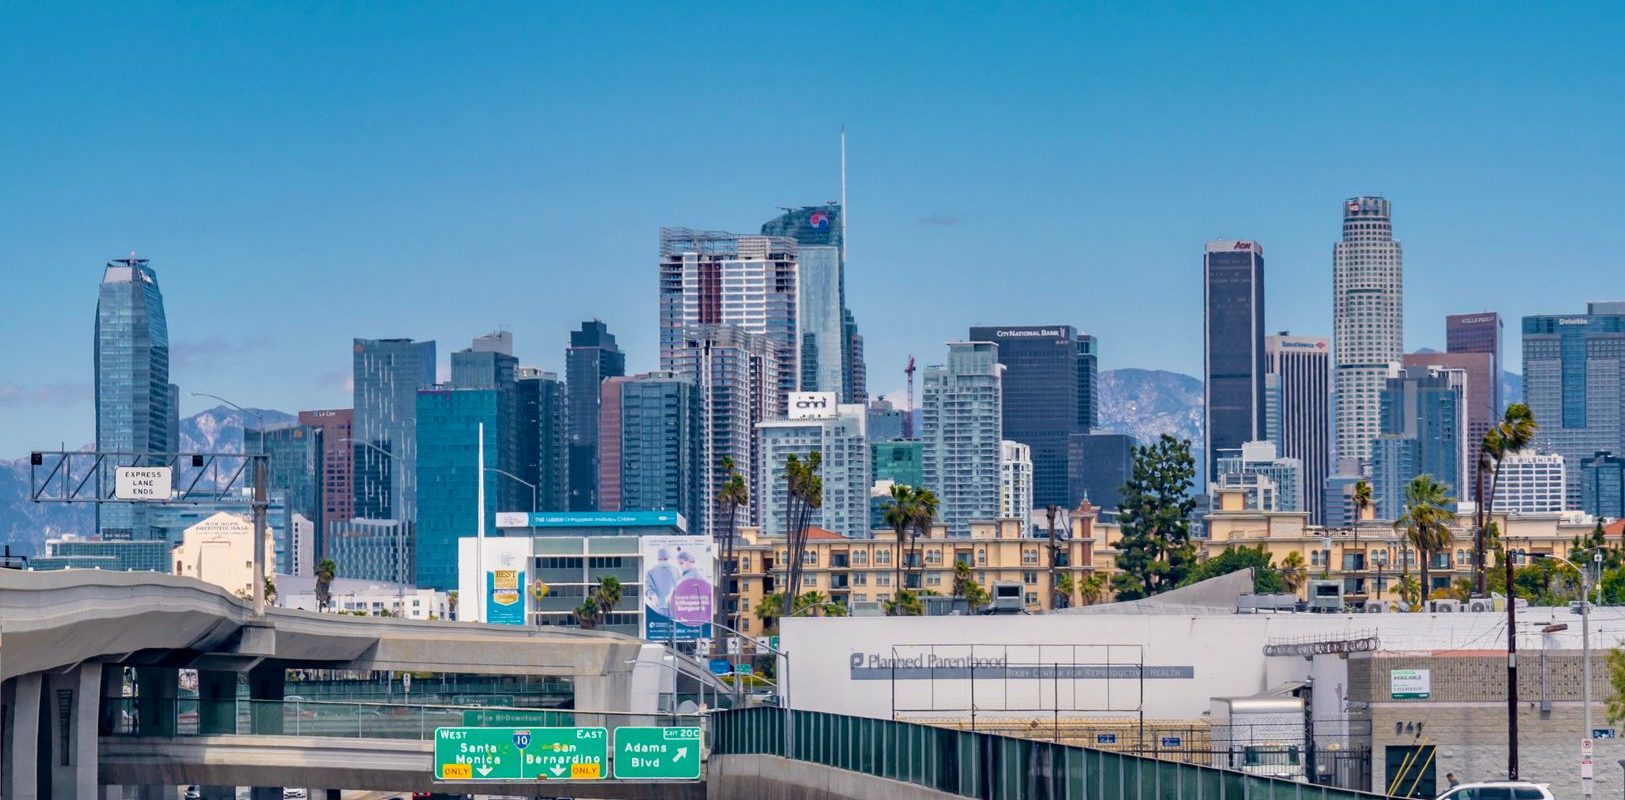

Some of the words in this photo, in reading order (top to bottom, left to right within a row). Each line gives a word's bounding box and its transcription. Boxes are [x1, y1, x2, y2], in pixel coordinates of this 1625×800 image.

[495, 569, 516, 578] BEST
[868, 653, 923, 669] Planned
[1006, 669, 1030, 677] BIXBY
[1087, 669, 1144, 677] REPRODUCTIV
[1150, 669, 1181, 677] HEALTH
[440, 730, 468, 739] WEST
[576, 730, 603, 739] EAST
[680, 729, 700, 737] 20C
[516, 735, 528, 745] 10
[460, 742, 497, 753] Santa
[552, 742, 577, 753] San
[624, 742, 667, 753] Adams
[455, 754, 501, 765] Monica
[526, 753, 601, 764] Bernardino
[631, 757, 660, 768] Blvd
[444, 768, 470, 776] ONLY
[572, 767, 598, 775] ONLY
